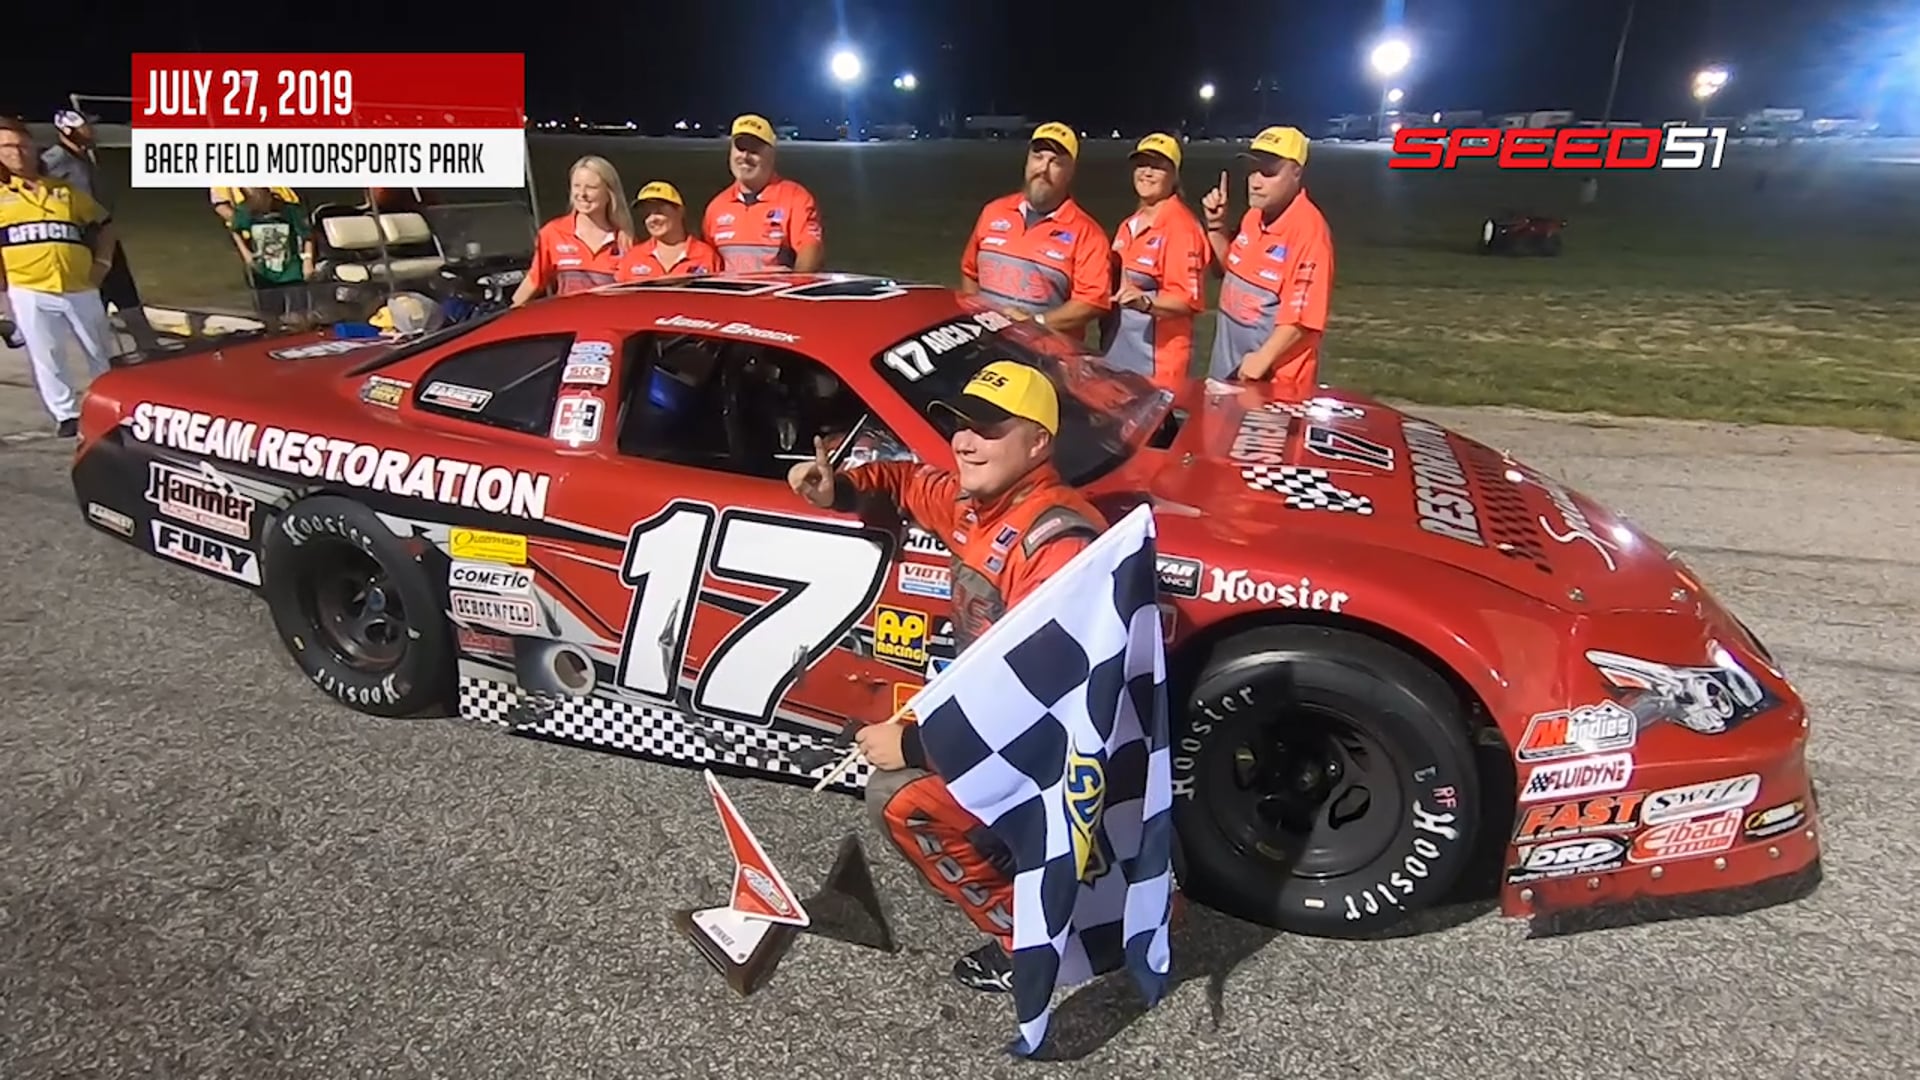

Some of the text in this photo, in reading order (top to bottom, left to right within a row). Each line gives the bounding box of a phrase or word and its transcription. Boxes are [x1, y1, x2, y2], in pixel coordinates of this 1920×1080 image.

[883, 340, 937, 381] 17
[921, 323, 976, 355] ARCA
[132, 402, 550, 519] STREAM RESTORATION
[1229, 410, 1291, 465] STREAM
[1304, 425, 1395, 471] 17
[149, 466, 252, 522] Hamner
[1401, 416, 1487, 547] RESTORATION
[158, 525, 252, 574] FURY
[281, 514, 374, 557] Hoosier
[457, 598, 530, 622] SCHOENFELD
[618, 499, 895, 727] 17
[1201, 566, 1349, 614] Hoosier
[876, 641, 924, 660] RACING
[313, 667, 401, 704] Hoosier
[1171, 686, 1253, 800] Hoosier
[1547, 760, 1626, 790] FLUIDYNE
[1520, 793, 1644, 835] FAST
[1344, 801, 1460, 920] Hoosier
[1525, 842, 1615, 868] DRP
